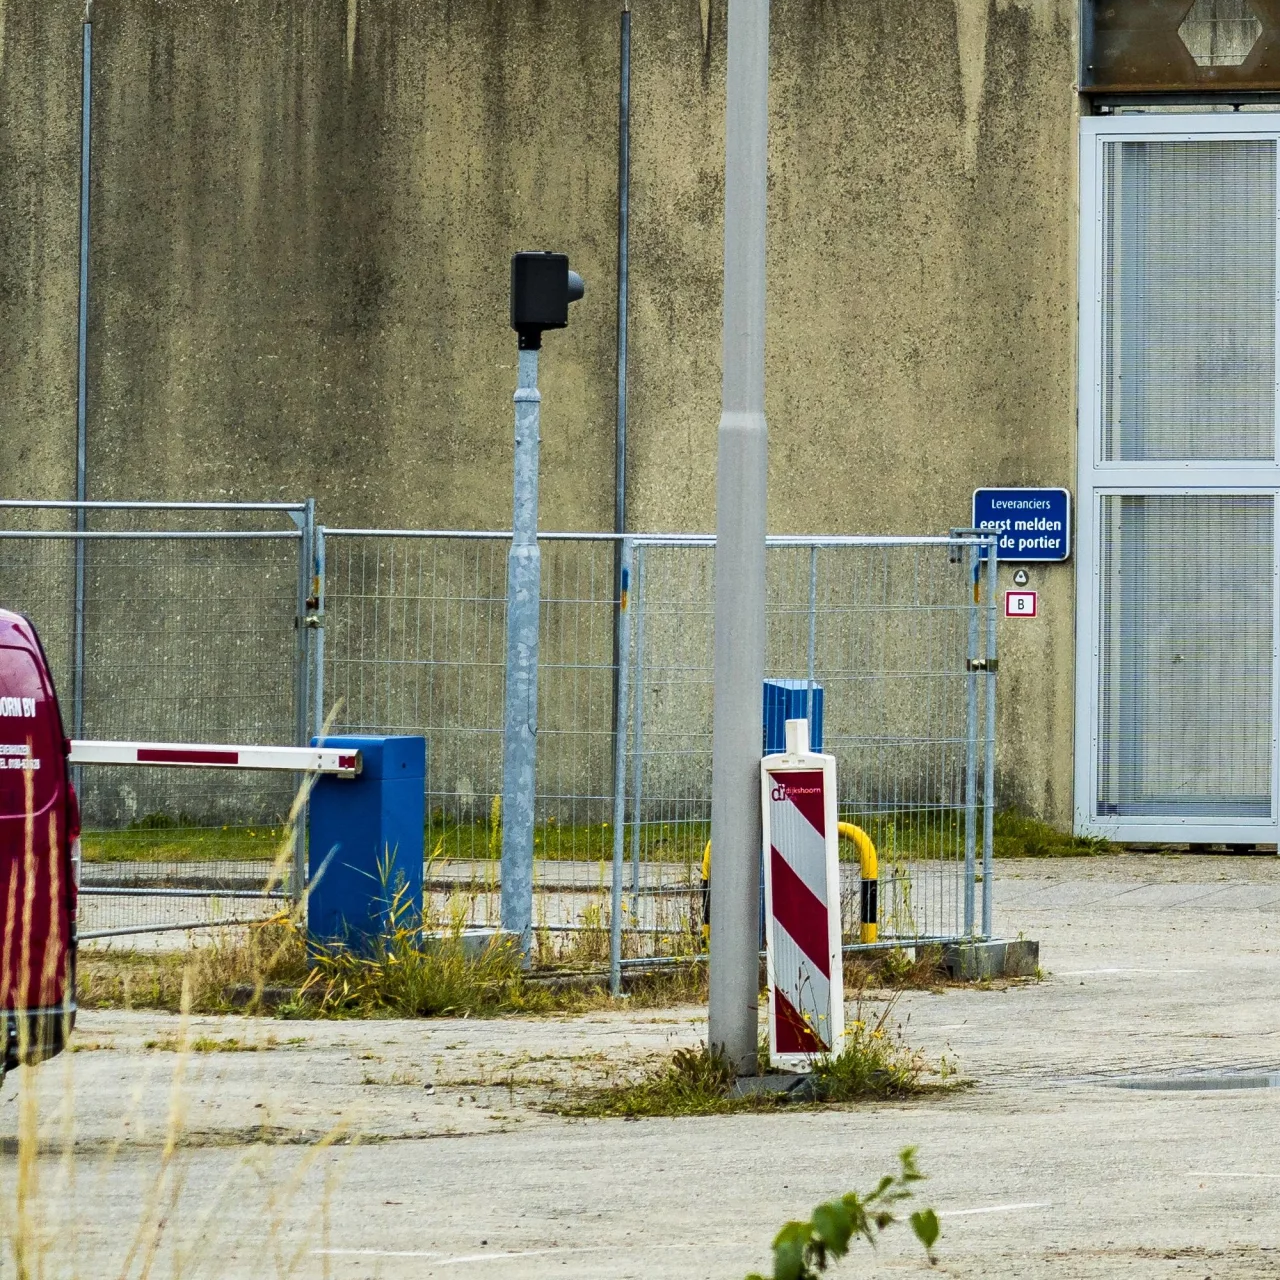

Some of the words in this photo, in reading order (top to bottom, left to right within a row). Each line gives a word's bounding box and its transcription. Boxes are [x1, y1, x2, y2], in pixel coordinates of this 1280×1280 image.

[991, 498, 1051, 509] Leveranciers
[980, 519, 1011, 531] eerst
[1014, 517, 1062, 531] melden
[1000, 535, 1015, 549] de
[1018, 535, 1061, 551] portier
[1017, 598, 1025, 610] B
[22, 698, 36, 718] BV
[786, 787, 821, 795] dijkshoorn
